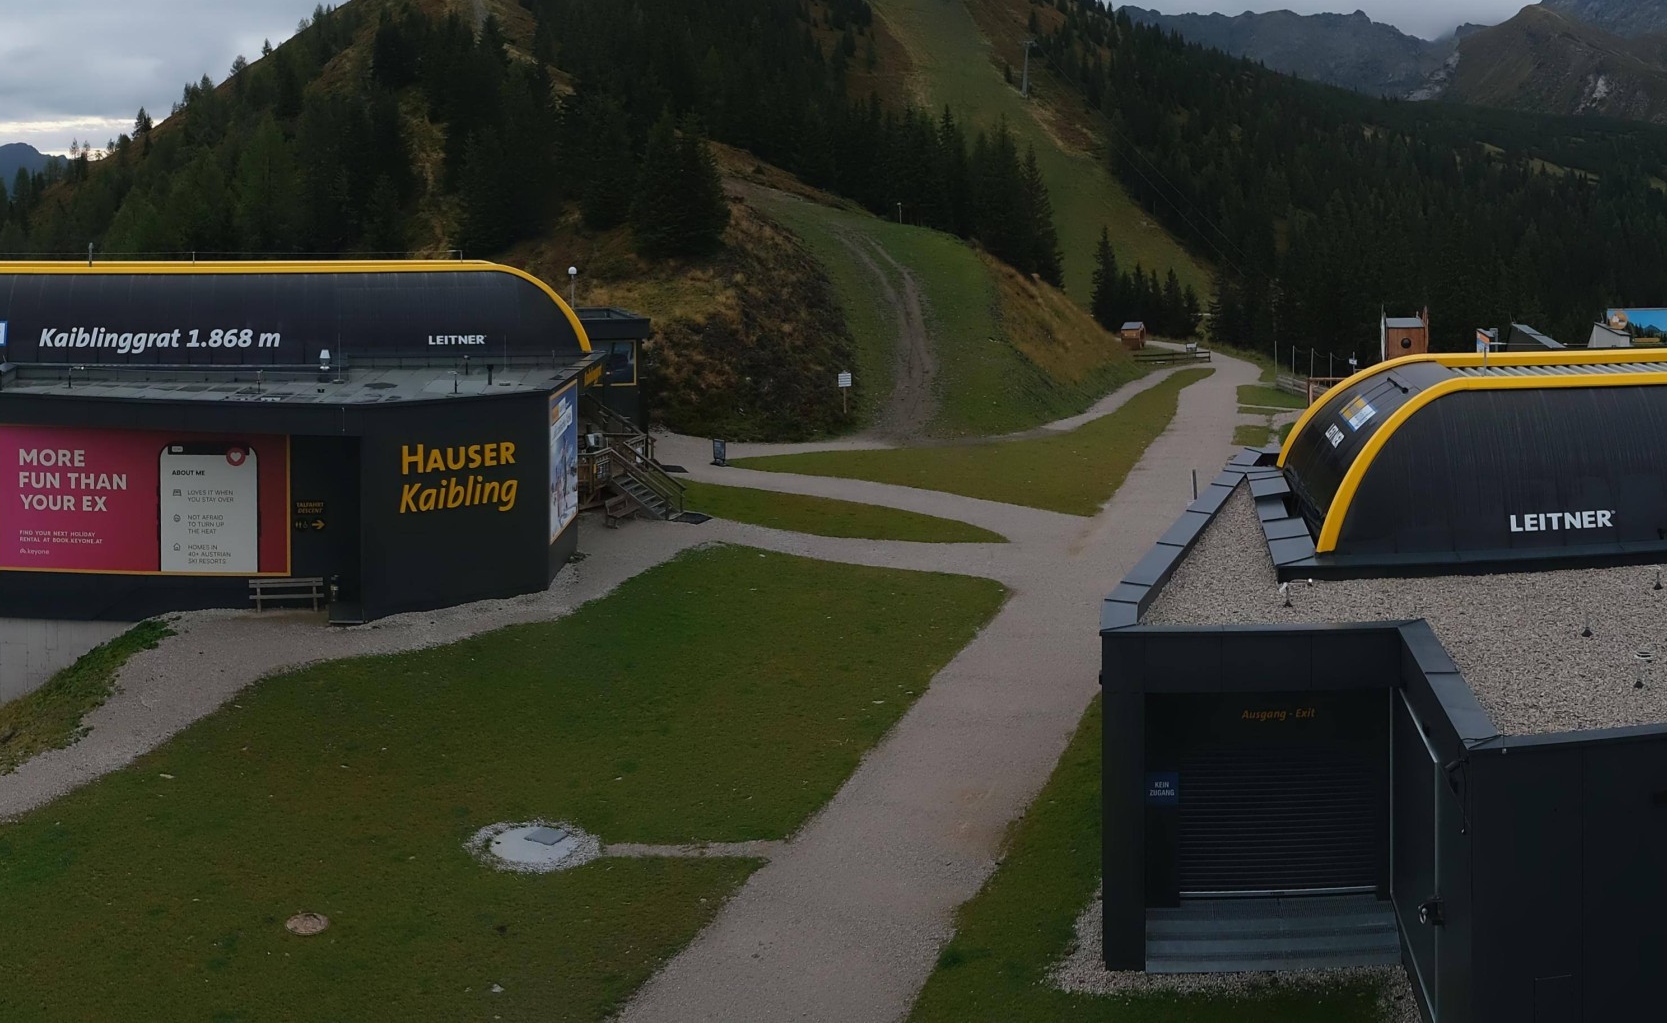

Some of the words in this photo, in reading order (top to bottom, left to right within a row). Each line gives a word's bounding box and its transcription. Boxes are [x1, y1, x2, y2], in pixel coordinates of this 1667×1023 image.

[39, 327, 181, 354] Kaiblinggrat
[186, 328, 253, 348] 1.868
[258, 332, 281, 348] m
[428, 334, 486, 345] LEITNER
[19, 448, 86, 467] MORE
[402, 441, 516, 475] HAUSER
[19, 472, 60, 488] FUN
[67, 473, 127, 490] THAN
[20, 494, 76, 511] YOUR
[82, 496, 108, 512] EX
[400, 475, 518, 514] Kaibling
[1510, 510, 1613, 532] LEITNER
[1242, 710, 1286, 721] Ausgang
[1296, 708, 1316, 718] Exit
